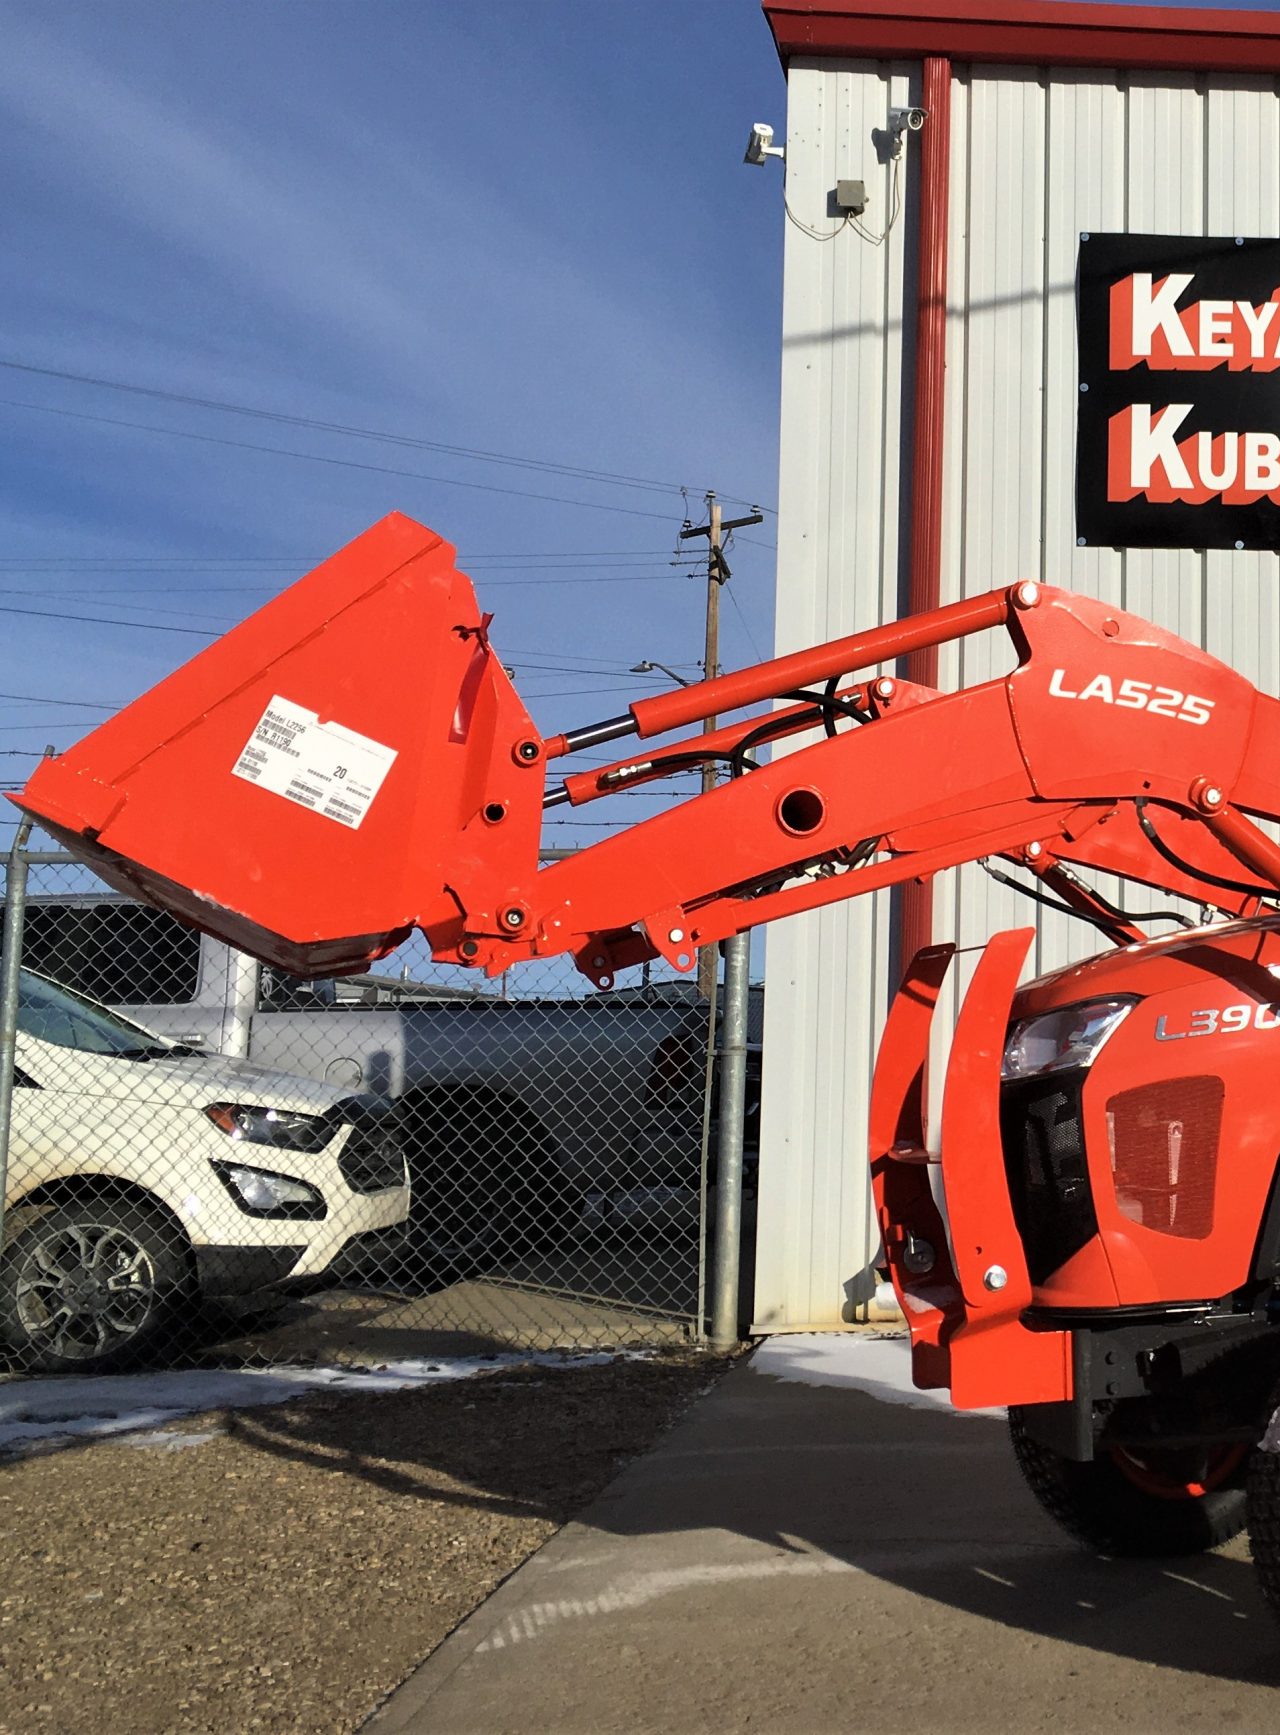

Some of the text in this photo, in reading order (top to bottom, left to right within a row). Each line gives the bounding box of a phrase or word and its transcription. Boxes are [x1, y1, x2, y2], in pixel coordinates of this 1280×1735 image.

[1049, 669, 1215, 725] LA525
[265, 710, 287, 724] Model
[333, 765, 348, 780] 20
